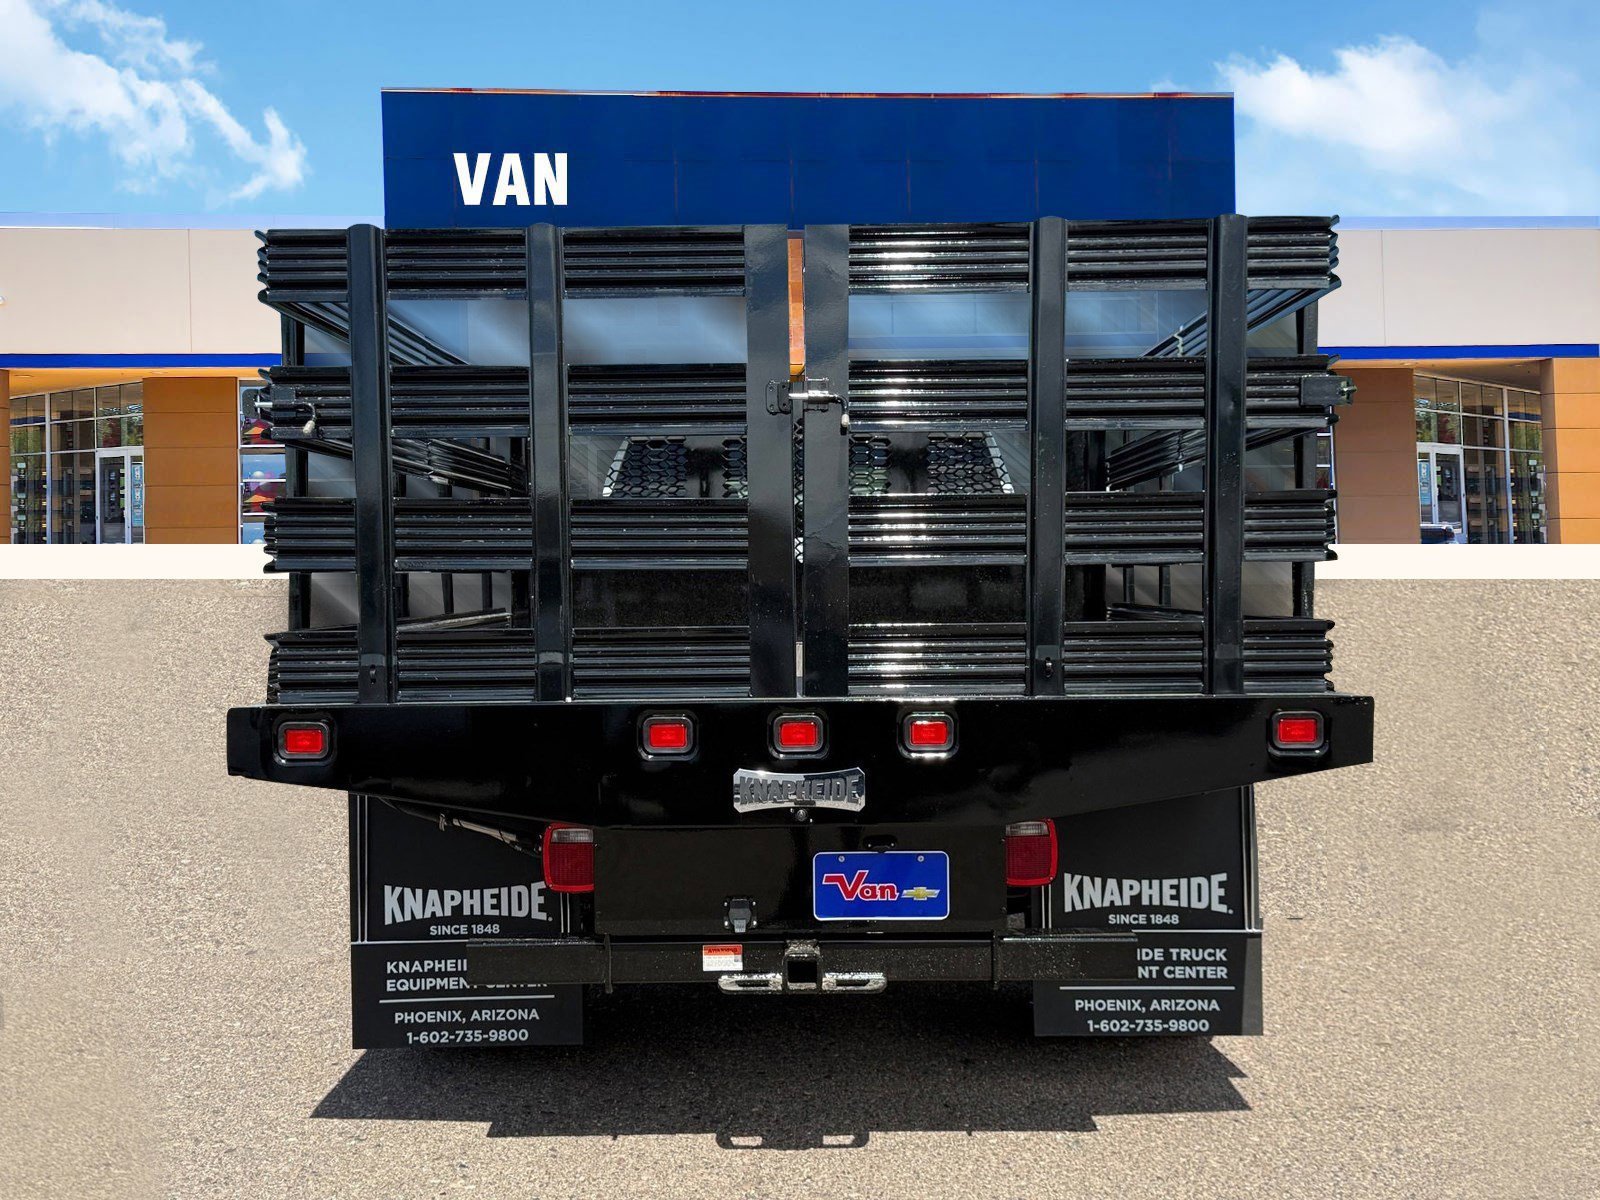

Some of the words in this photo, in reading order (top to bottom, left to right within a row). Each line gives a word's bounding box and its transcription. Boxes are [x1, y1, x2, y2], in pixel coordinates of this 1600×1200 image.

[452, 152, 568, 206] VAN
[739, 774, 861, 805] KNAPHEIDE
[822, 870, 900, 901] Van
[1108, 913, 1148, 925] SINCE
[1149, 913, 1180, 925] 1848
[429, 924, 469, 936] SINCE
[471, 923, 501, 935] 1848
[1168, 948, 1228, 961] TRUCK
[386, 959, 468, 974] KNAPHEI
[1163, 965, 1228, 979] CENTER
[386, 977, 478, 992] EQUIPMEN
[1074, 999, 1147, 1013] PHOENIX,
[1149, 999, 1221, 1012] ARIZONA
[394, 1010, 467, 1024] PHOENIX,
[469, 1008, 540, 1022] ARIZONA
[1086, 1018, 1210, 1033] 1-602-735-9800
[406, 1028, 529, 1044] 1-602-735-9800
